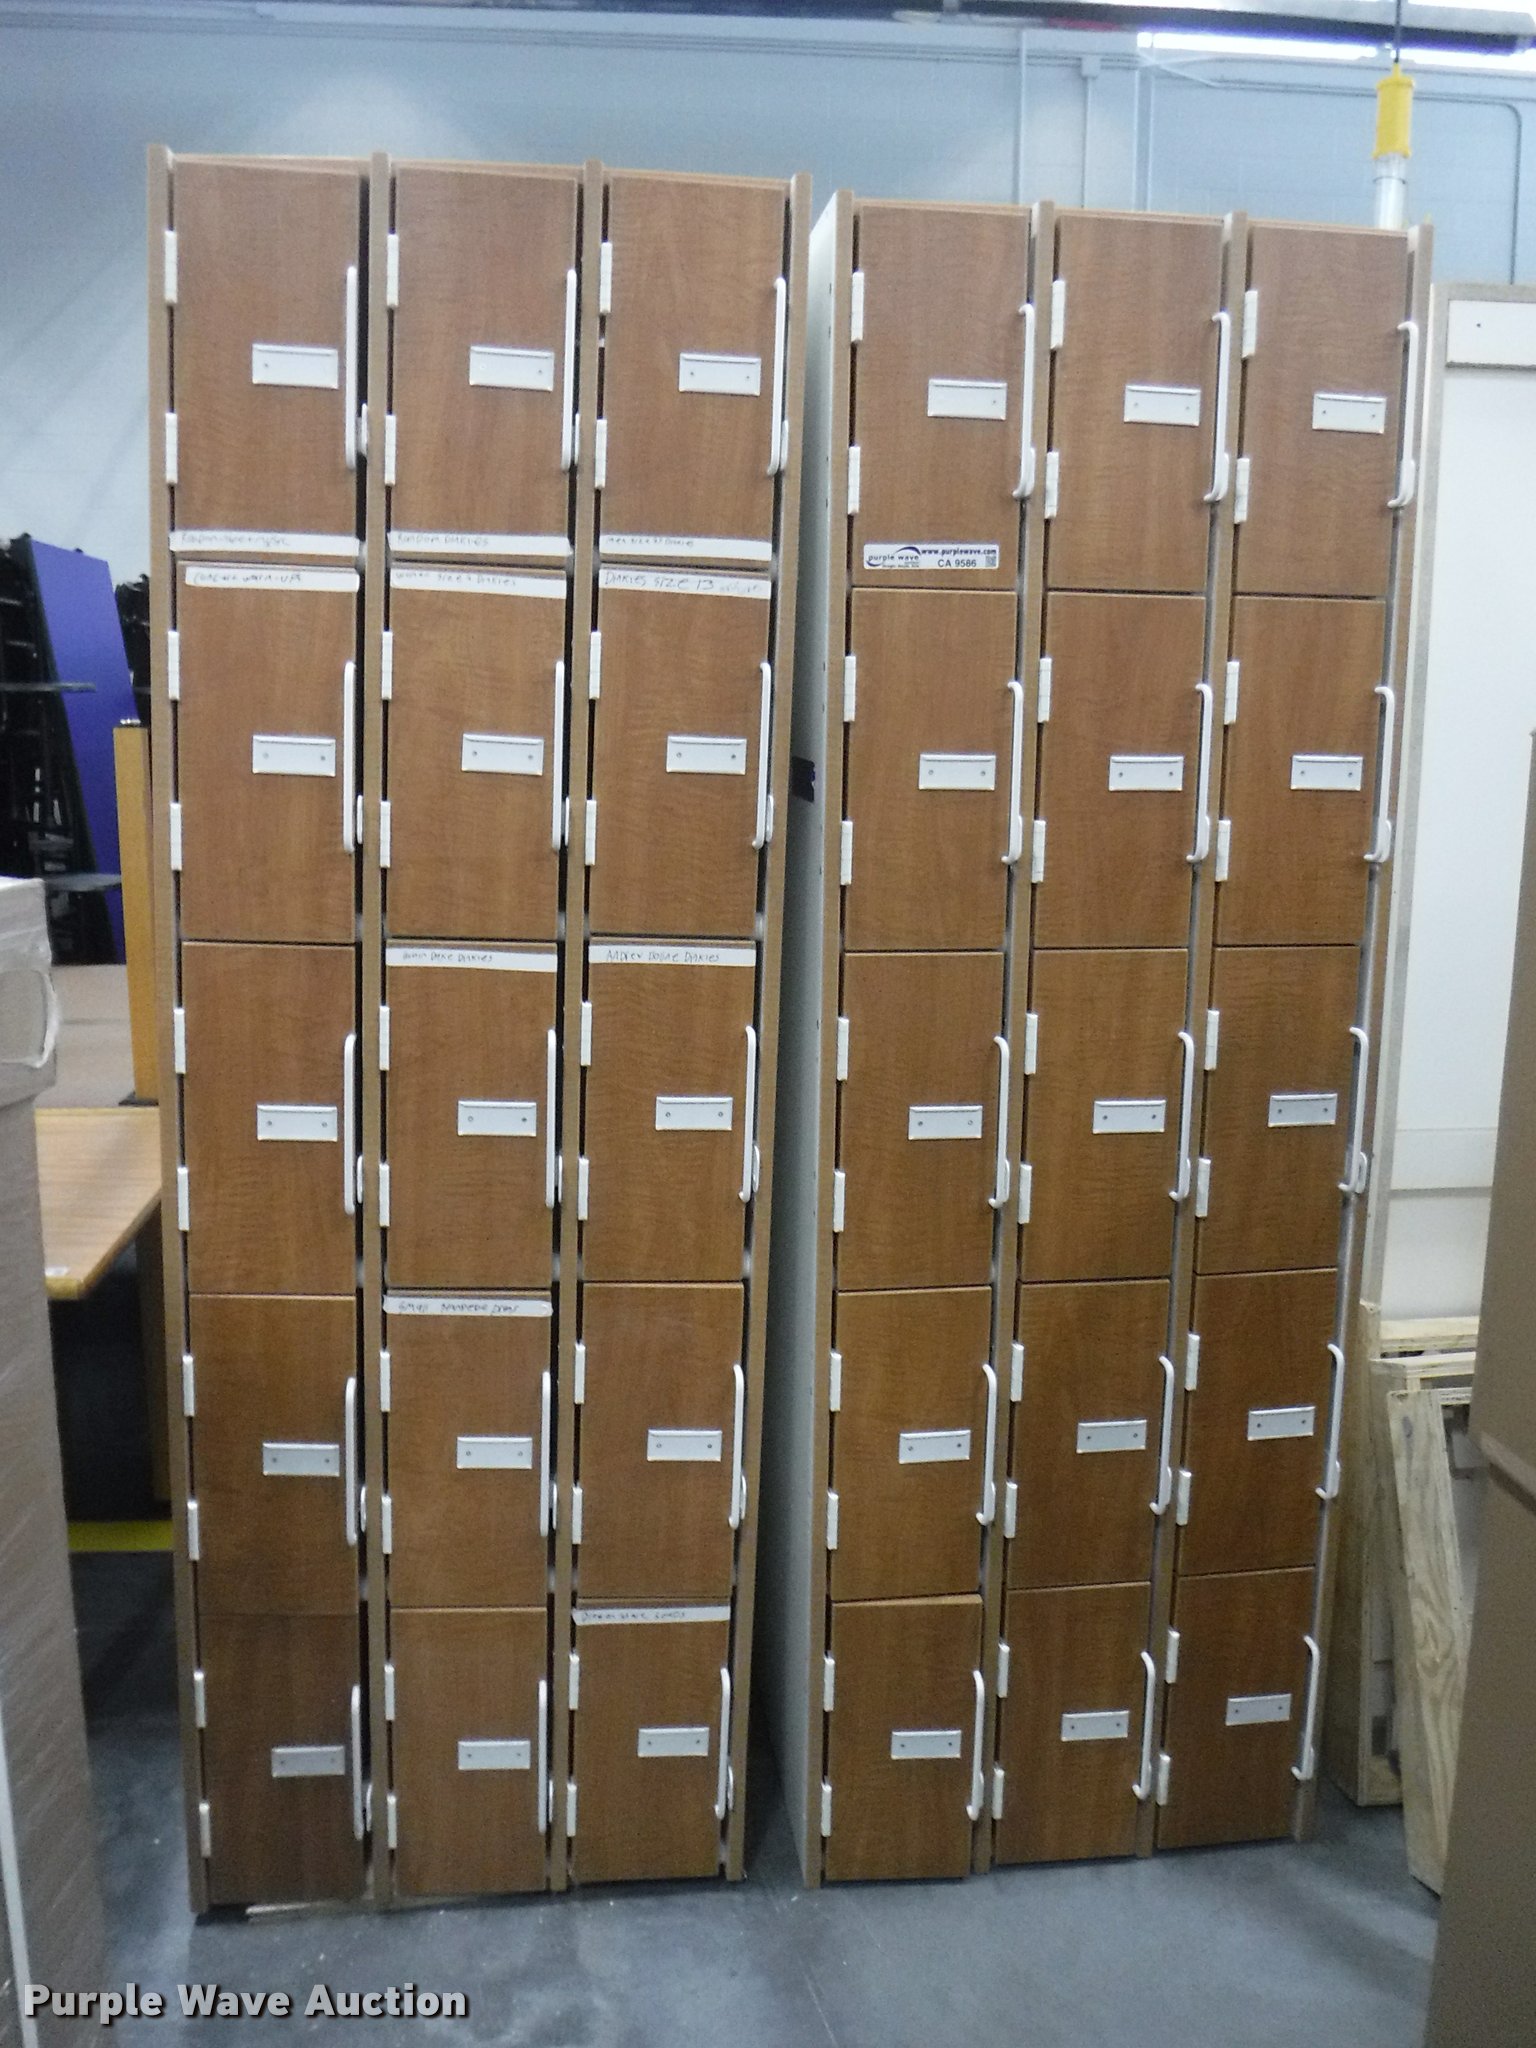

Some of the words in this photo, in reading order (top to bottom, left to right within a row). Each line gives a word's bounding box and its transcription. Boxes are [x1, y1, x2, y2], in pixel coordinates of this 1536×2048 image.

[921, 548, 996, 557] www.purplewave.com
[937, 559, 952, 568] CA
[954, 559, 977, 568] 9586
